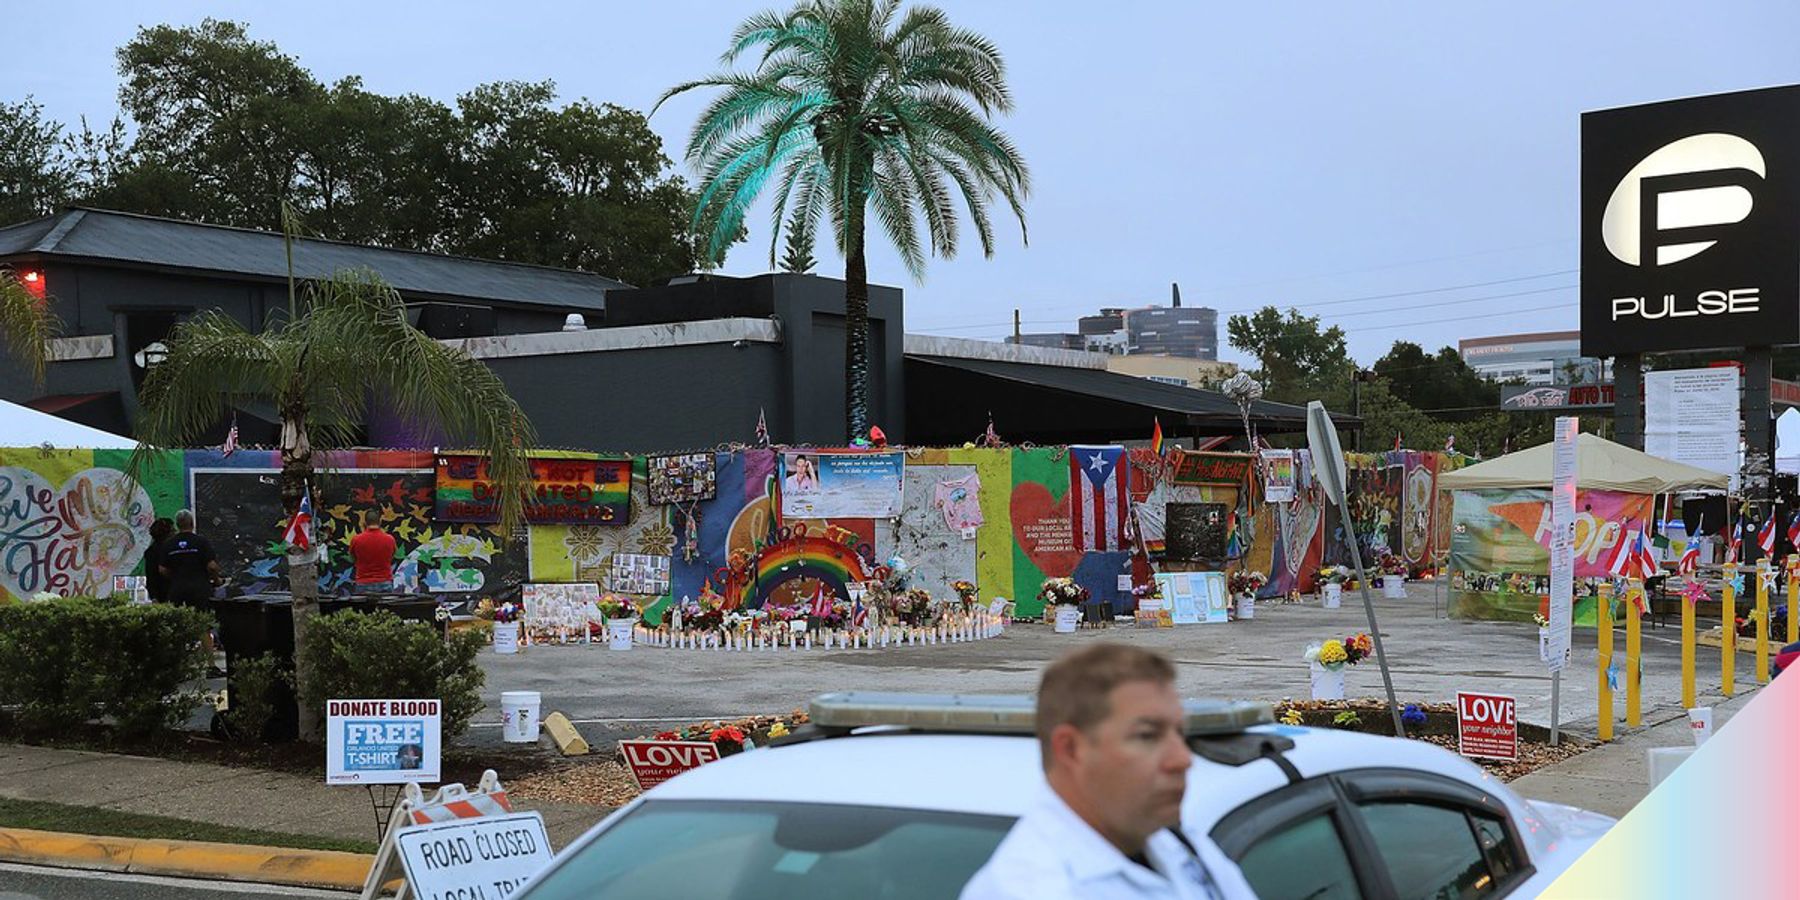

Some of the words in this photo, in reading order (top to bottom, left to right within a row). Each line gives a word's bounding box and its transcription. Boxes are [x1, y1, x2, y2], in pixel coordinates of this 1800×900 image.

[1612, 287, 1760, 321] PULSE
[1567, 386, 1600, 405] AUTO
[1600, 385, 1615, 403] TI
[547, 466, 590, 482] NOT
[596, 467, 621, 484] BE
[330, 702, 386, 716] DONATE
[390, 702, 438, 716] BLOOD
[1461, 697, 1514, 724] LOVE
[347, 723, 421, 744] FREE
[1463, 725, 1480, 734] your
[346, 752, 399, 765] T-SHIRT
[628, 746, 712, 766] LOVE
[637, 767, 662, 776] your
[420, 836, 473, 870] ROAD
[474, 829, 537, 861] CLOSED
